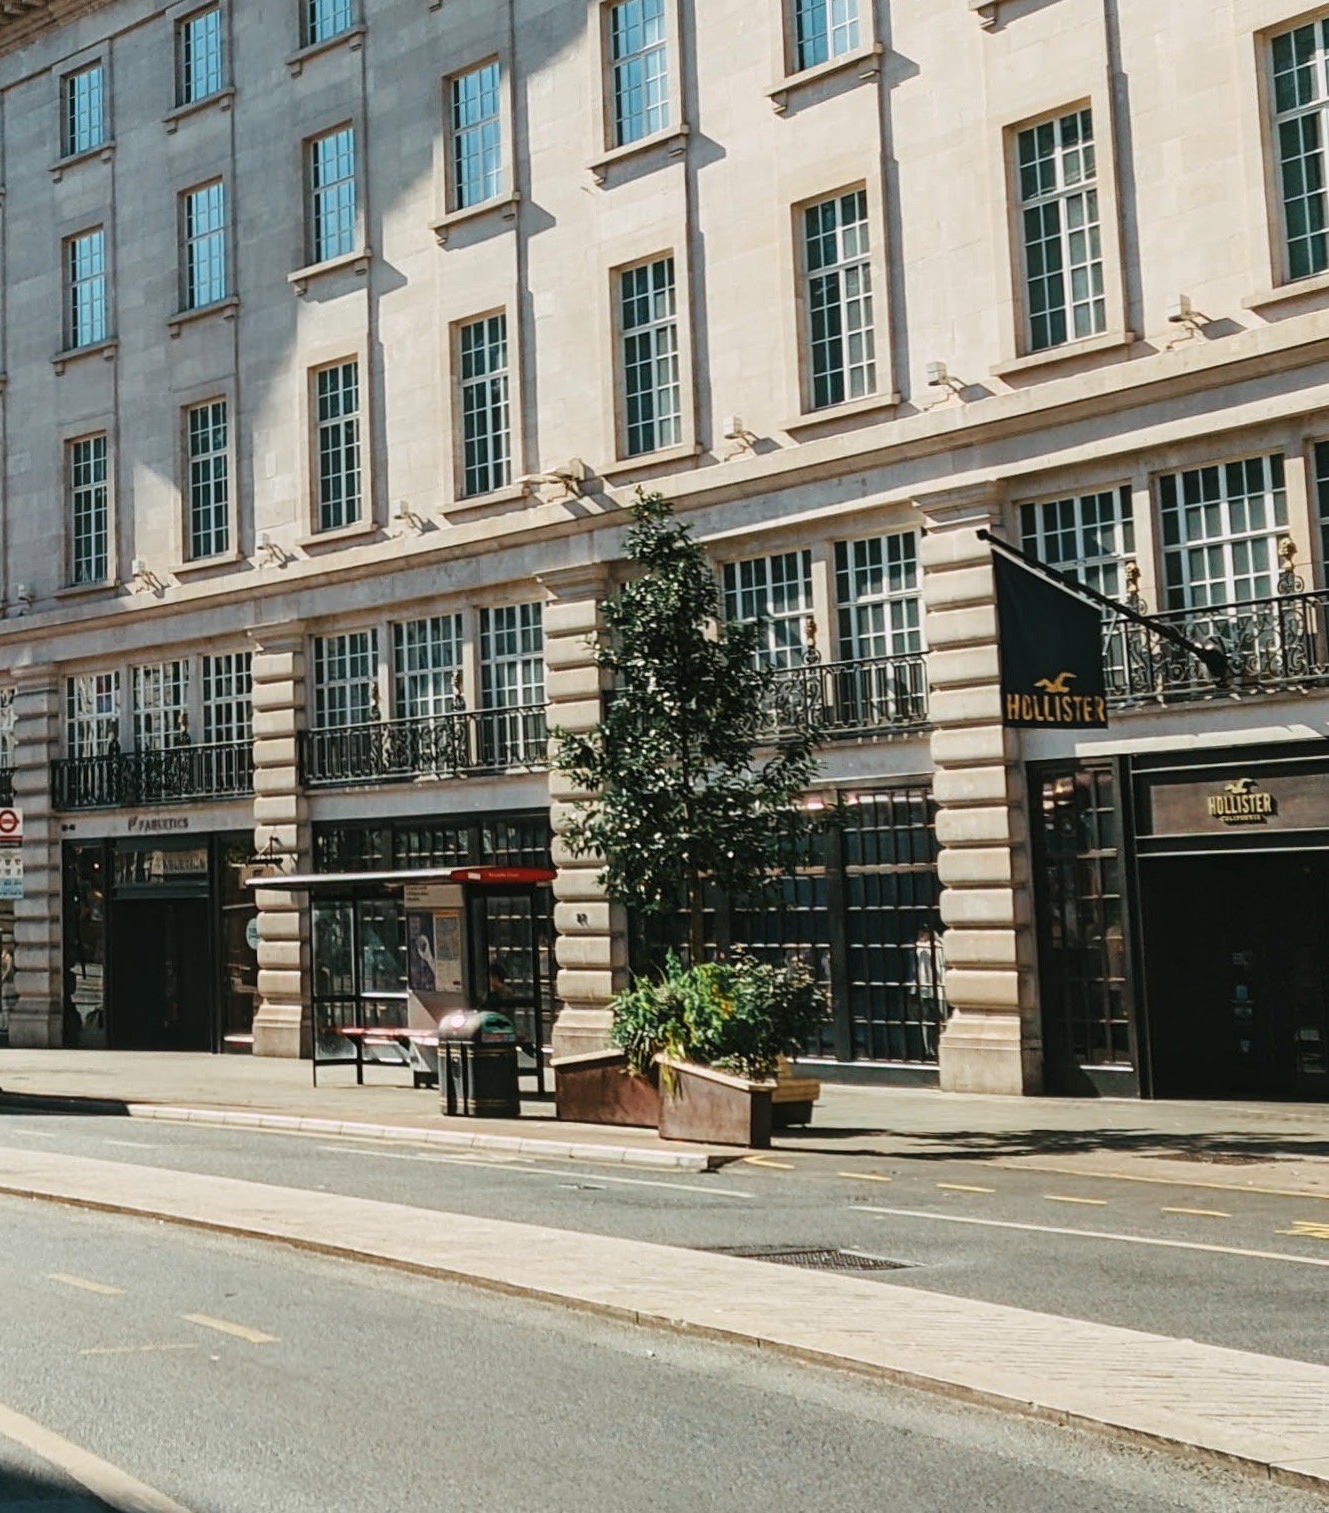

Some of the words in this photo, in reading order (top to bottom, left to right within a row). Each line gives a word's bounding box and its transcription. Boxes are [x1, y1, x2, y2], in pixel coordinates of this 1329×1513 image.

[1006, 693, 1106, 722] HOLLISTER
[1208, 792, 1272, 815] HOLLISTER
[139, 817, 189, 832] FABLETICS
